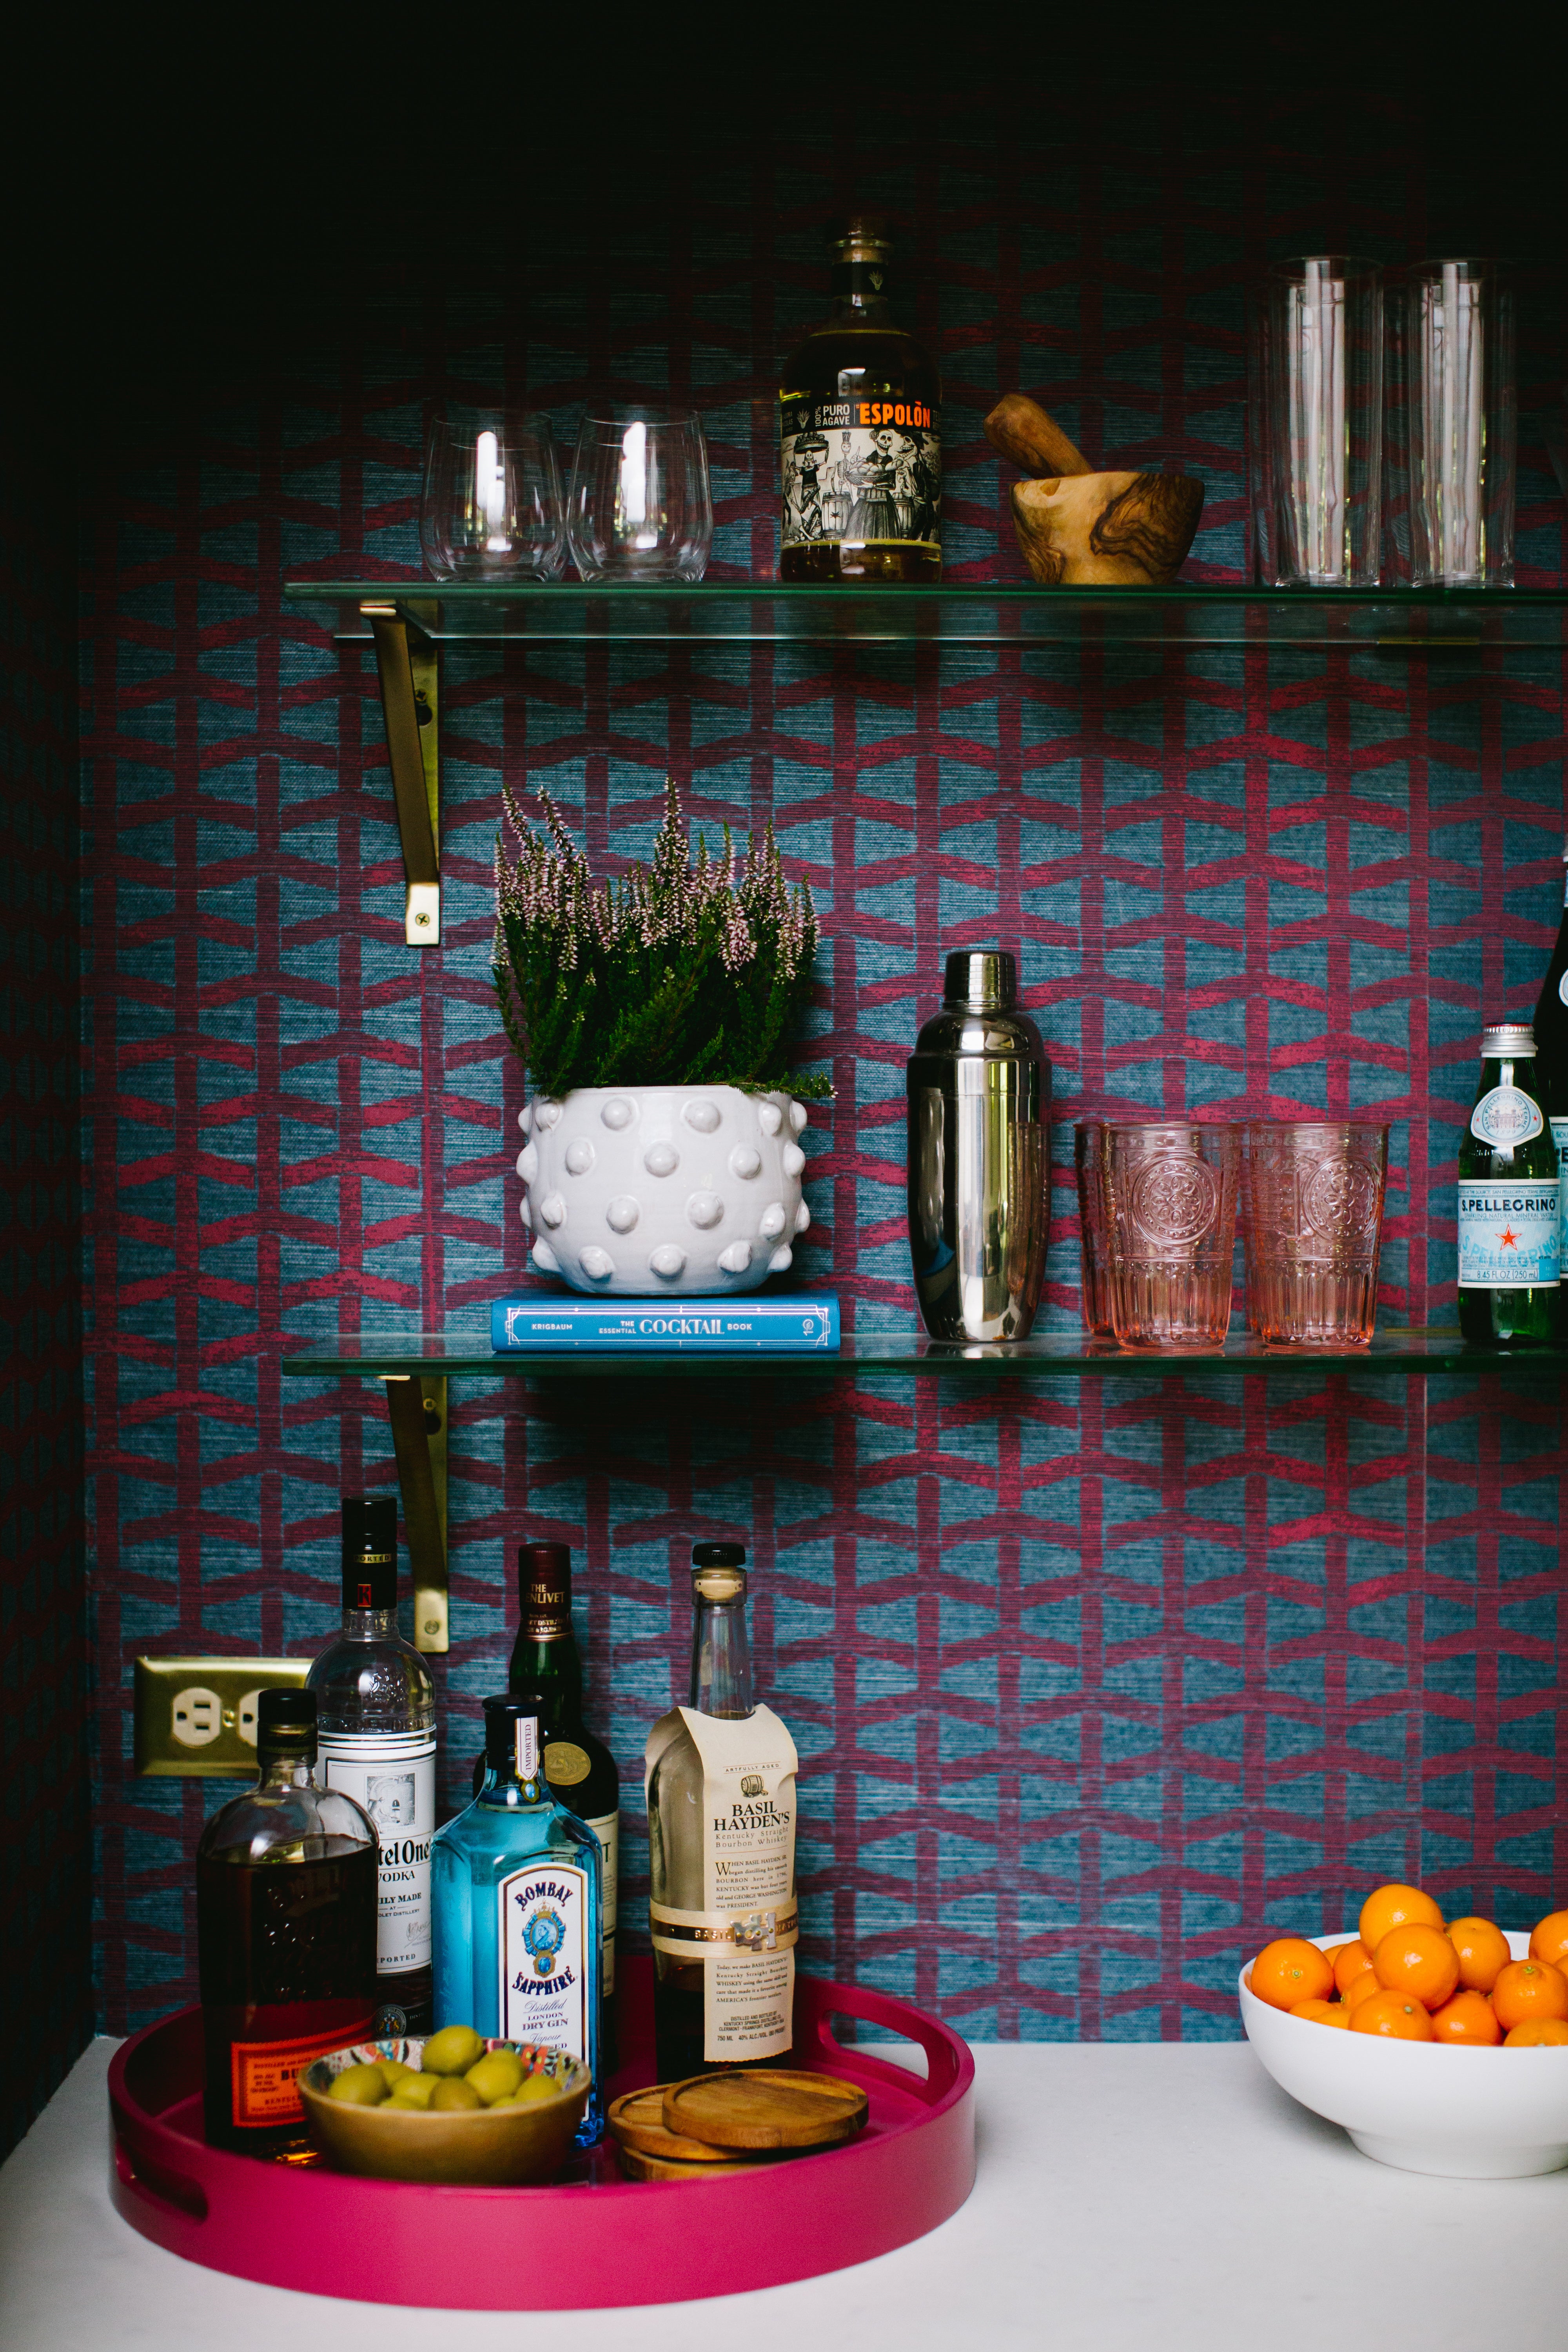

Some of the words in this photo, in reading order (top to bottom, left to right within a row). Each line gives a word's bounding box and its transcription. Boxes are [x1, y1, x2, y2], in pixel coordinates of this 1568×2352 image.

[823, 405, 850, 416] PURO
[823, 416, 850, 426] AGAVE
[1462, 1199, 1555, 1212] S.PELLEGRINO
[640, 1319, 725, 1334] COCKTAIL
[530, 1584, 547, 1592] THE
[359, 1586, 371, 1606] K
[525, 1592, 565, 1603] ENLIVET
[732, 1800, 777, 1817] BASIL
[713, 1811, 790, 1831] HAYDEN'S
[761, 1826, 788, 1837] Straight
[758, 1836, 787, 1845] Whiskey
[379, 1842, 399, 1866] tel
[402, 1840, 429, 1864] One
[398, 1892, 421, 1902] MADE
[514, 1881, 574, 1911] BOMBAY
[757, 1887, 787, 1897] WASHINGTON
[695, 1929, 732, 1939] BASIL
[377, 1953, 416, 1963] PORTED
[512, 1965, 576, 1995] SAPPHIRE
[523, 1998, 568, 2014] Distilled
[528, 2012, 563, 2021] LONDON
[522, 2021, 546, 2031] DRY
[547, 2018, 569, 2027] GIN
[530, 2032, 561, 2044] Vapour
